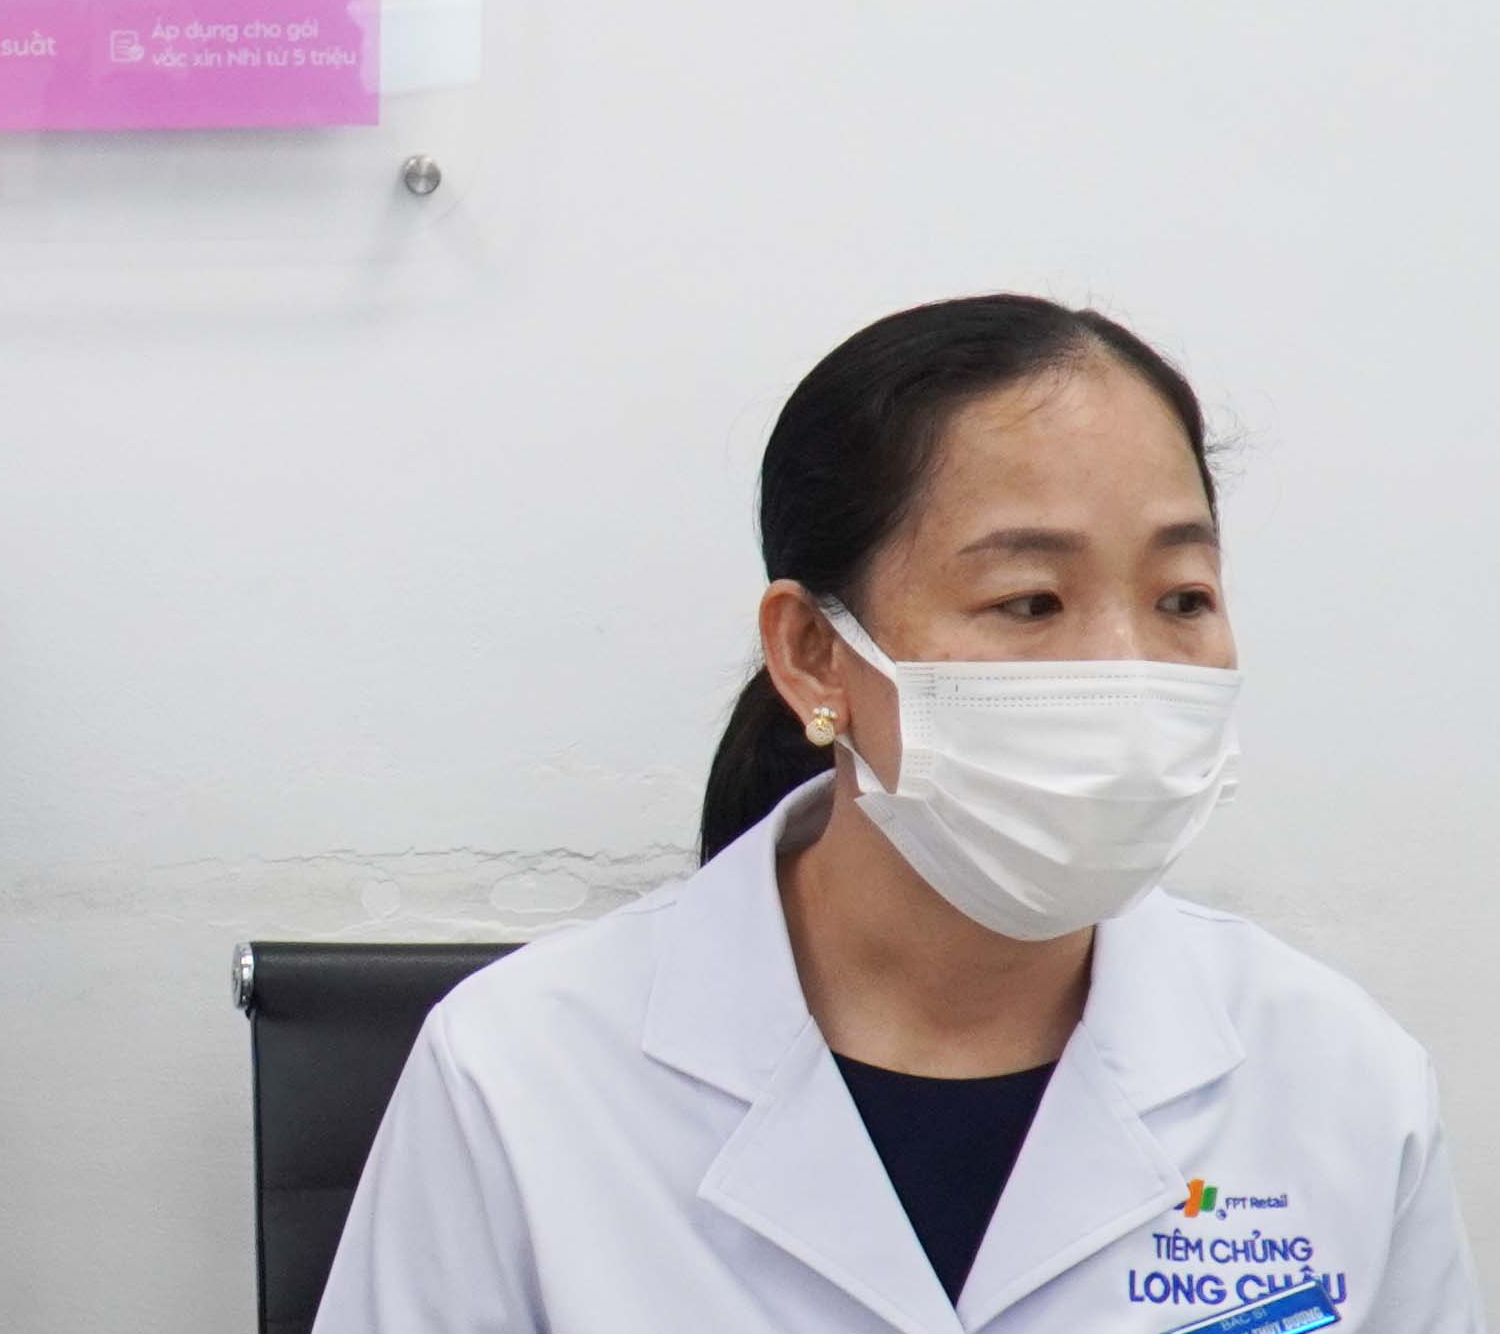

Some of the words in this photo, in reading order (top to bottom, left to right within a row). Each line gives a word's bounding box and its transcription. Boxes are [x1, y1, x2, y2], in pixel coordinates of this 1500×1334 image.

[151, 17, 180, 42] Áp
[185, 20, 239, 43] dụng
[242, 20, 281, 39] cho
[286, 19, 319, 42] gói
[294, 48, 307, 65] 5
[310, 47, 357, 69] triệu
[1225, 1196, 1249, 1210] FPT
[1250, 1194, 1289, 1209] Retail
[1152, 1228, 1205, 1263] TIÊM
[1209, 1230, 1314, 1263] CHỦNG
[1128, 1269, 1228, 1305] LONG
